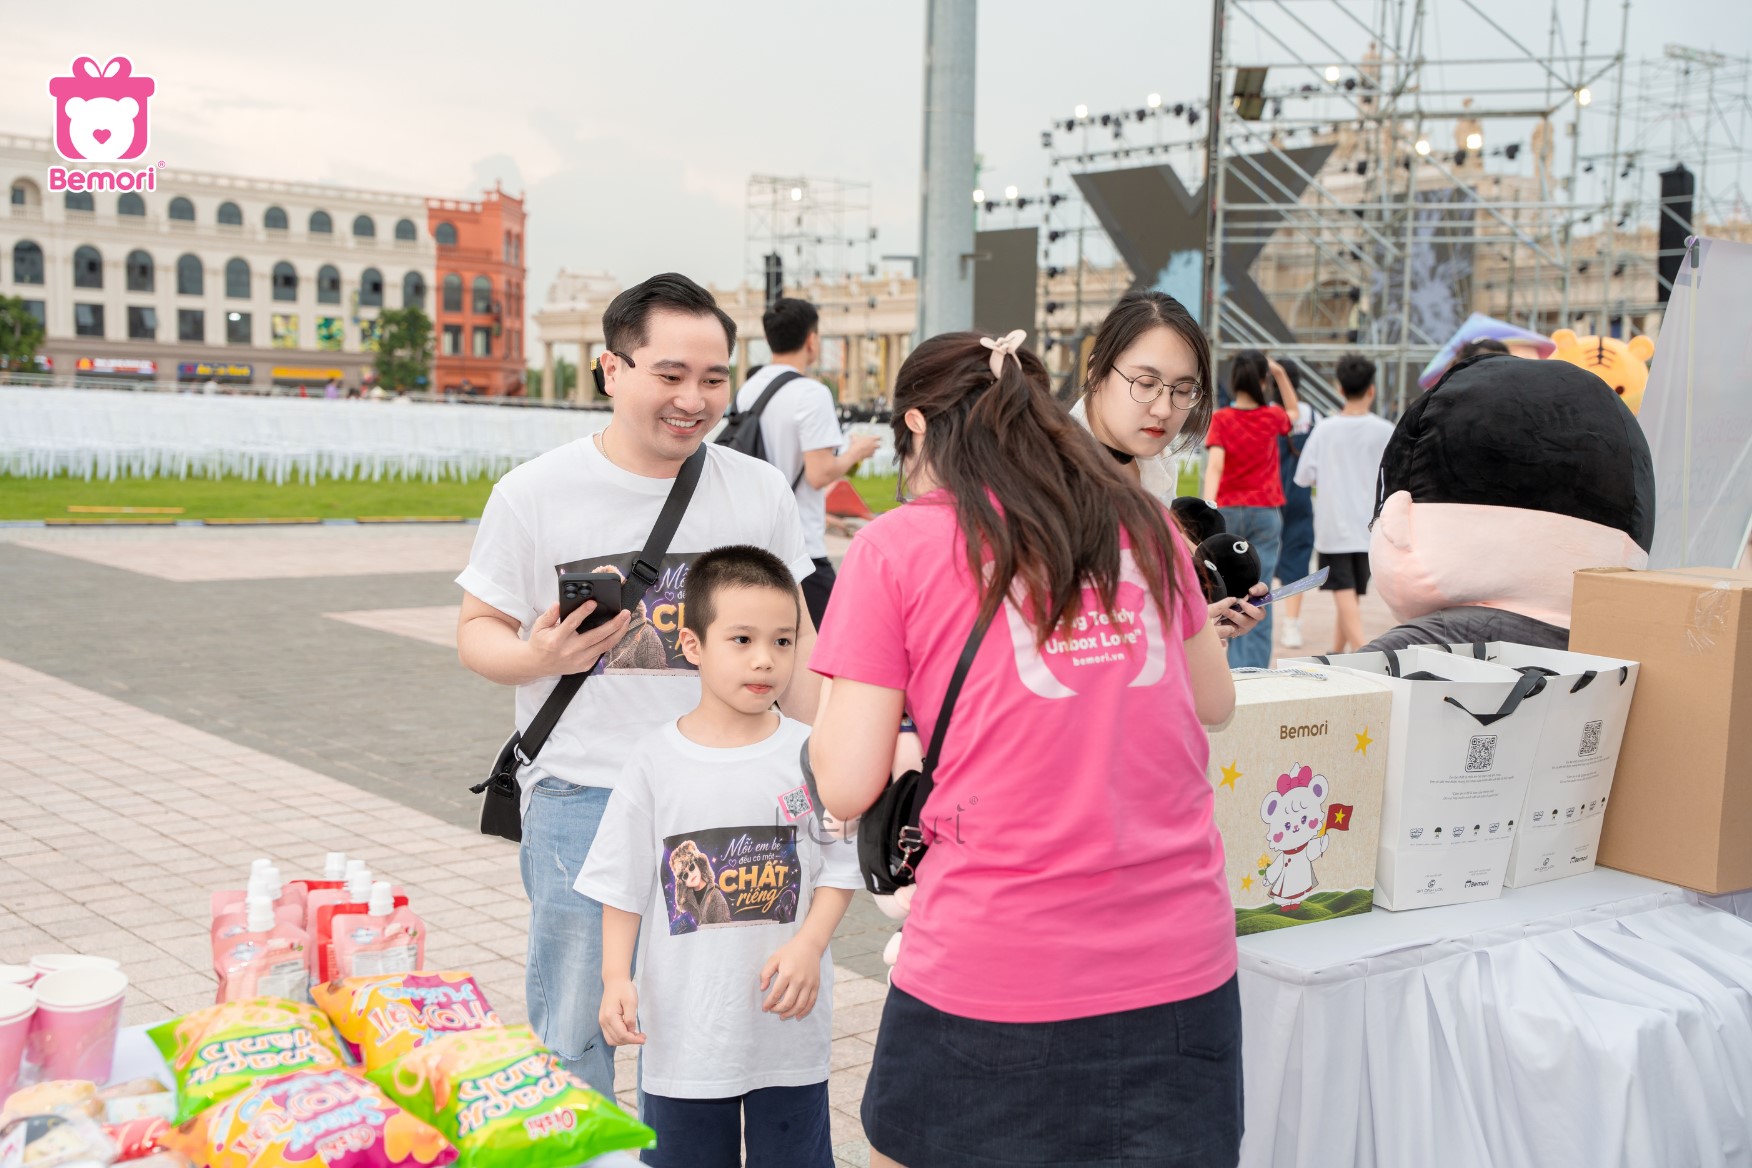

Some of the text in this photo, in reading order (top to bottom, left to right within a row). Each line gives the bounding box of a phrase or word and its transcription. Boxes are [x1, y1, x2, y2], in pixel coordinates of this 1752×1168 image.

[1045, 637, 1098, 654] Unbox
[1072, 652, 1125, 666] bemori.vn
[1280, 720, 1328, 739] Bemori
[720, 834, 783, 861] Mỗi em bé
[753, 854, 761, 862] có
[719, 860, 789, 893] CHẤT
[736, 887, 778, 914] riêng
[527, 1108, 575, 1137] Oishi
